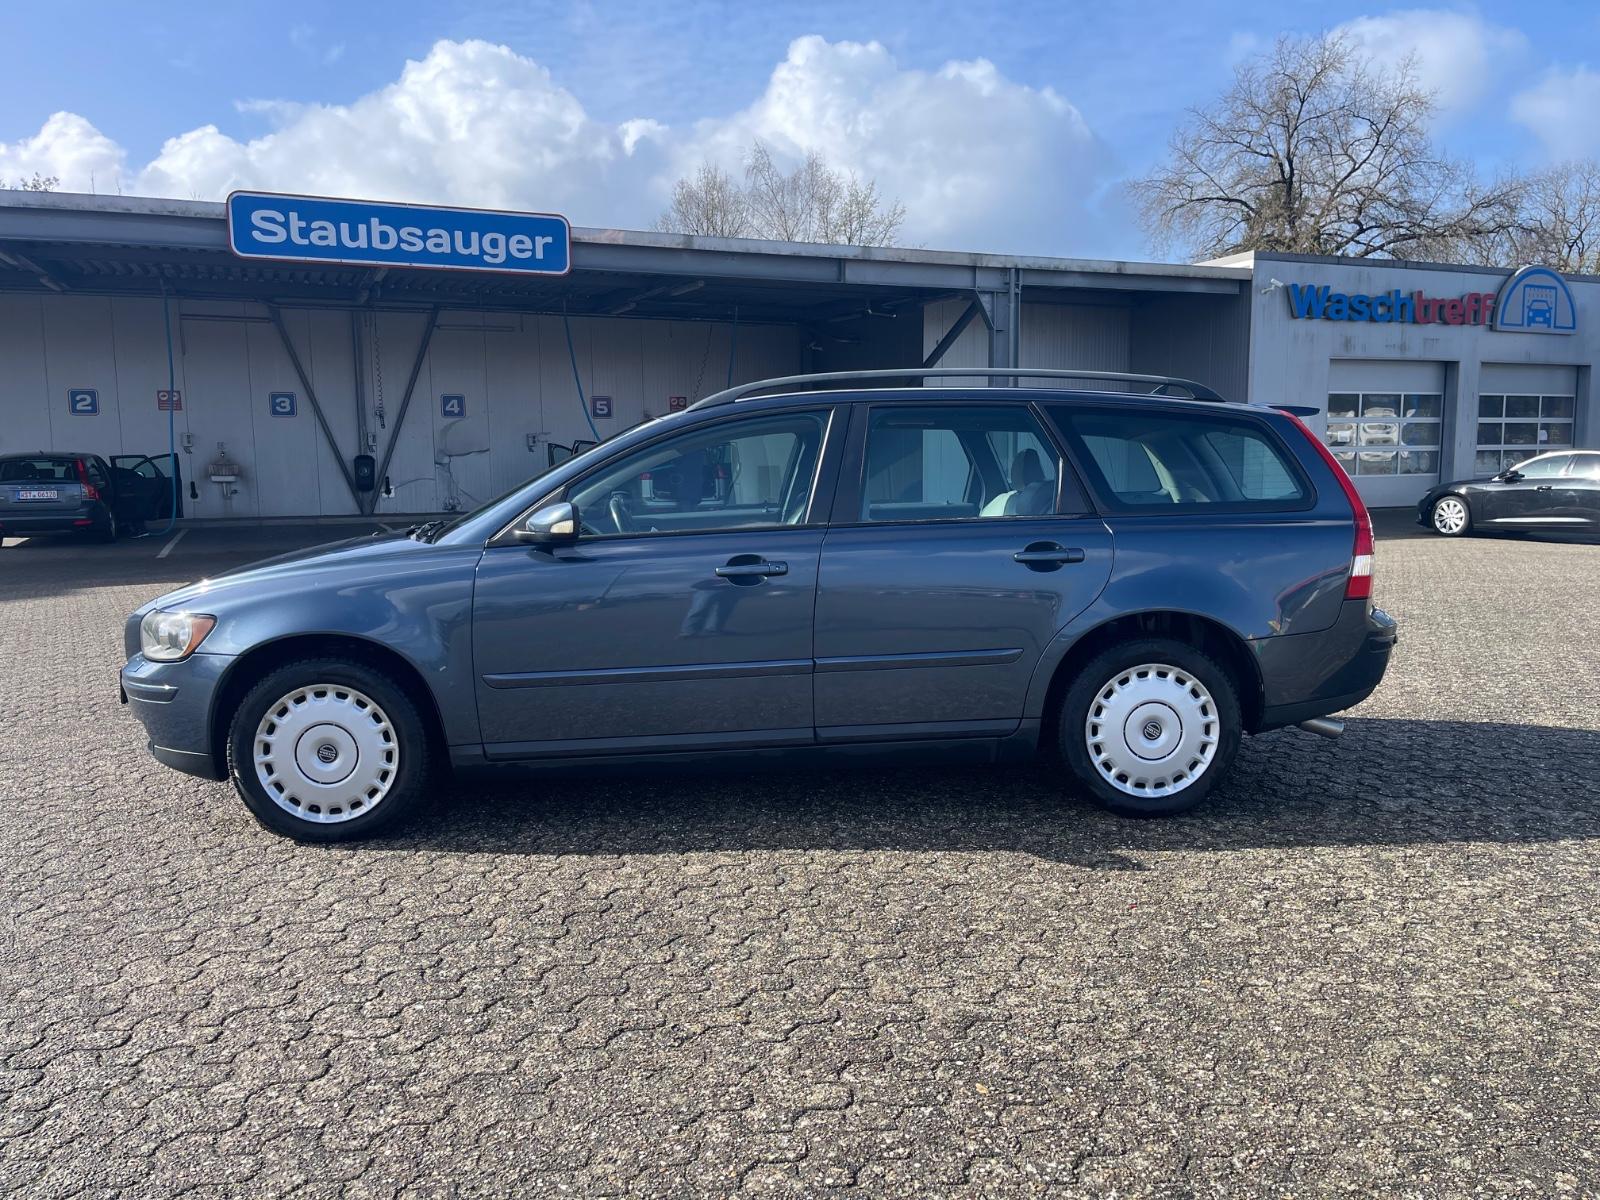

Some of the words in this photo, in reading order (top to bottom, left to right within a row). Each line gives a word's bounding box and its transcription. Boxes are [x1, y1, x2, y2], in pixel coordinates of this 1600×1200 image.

[250, 209, 553, 264] Staubsauger
[1288, 283, 1496, 325] Waschtreff
[75, 394, 92, 410] 2
[275, 397, 291, 412] 3
[445, 399, 460, 414] 4
[596, 400, 609, 415] 5
